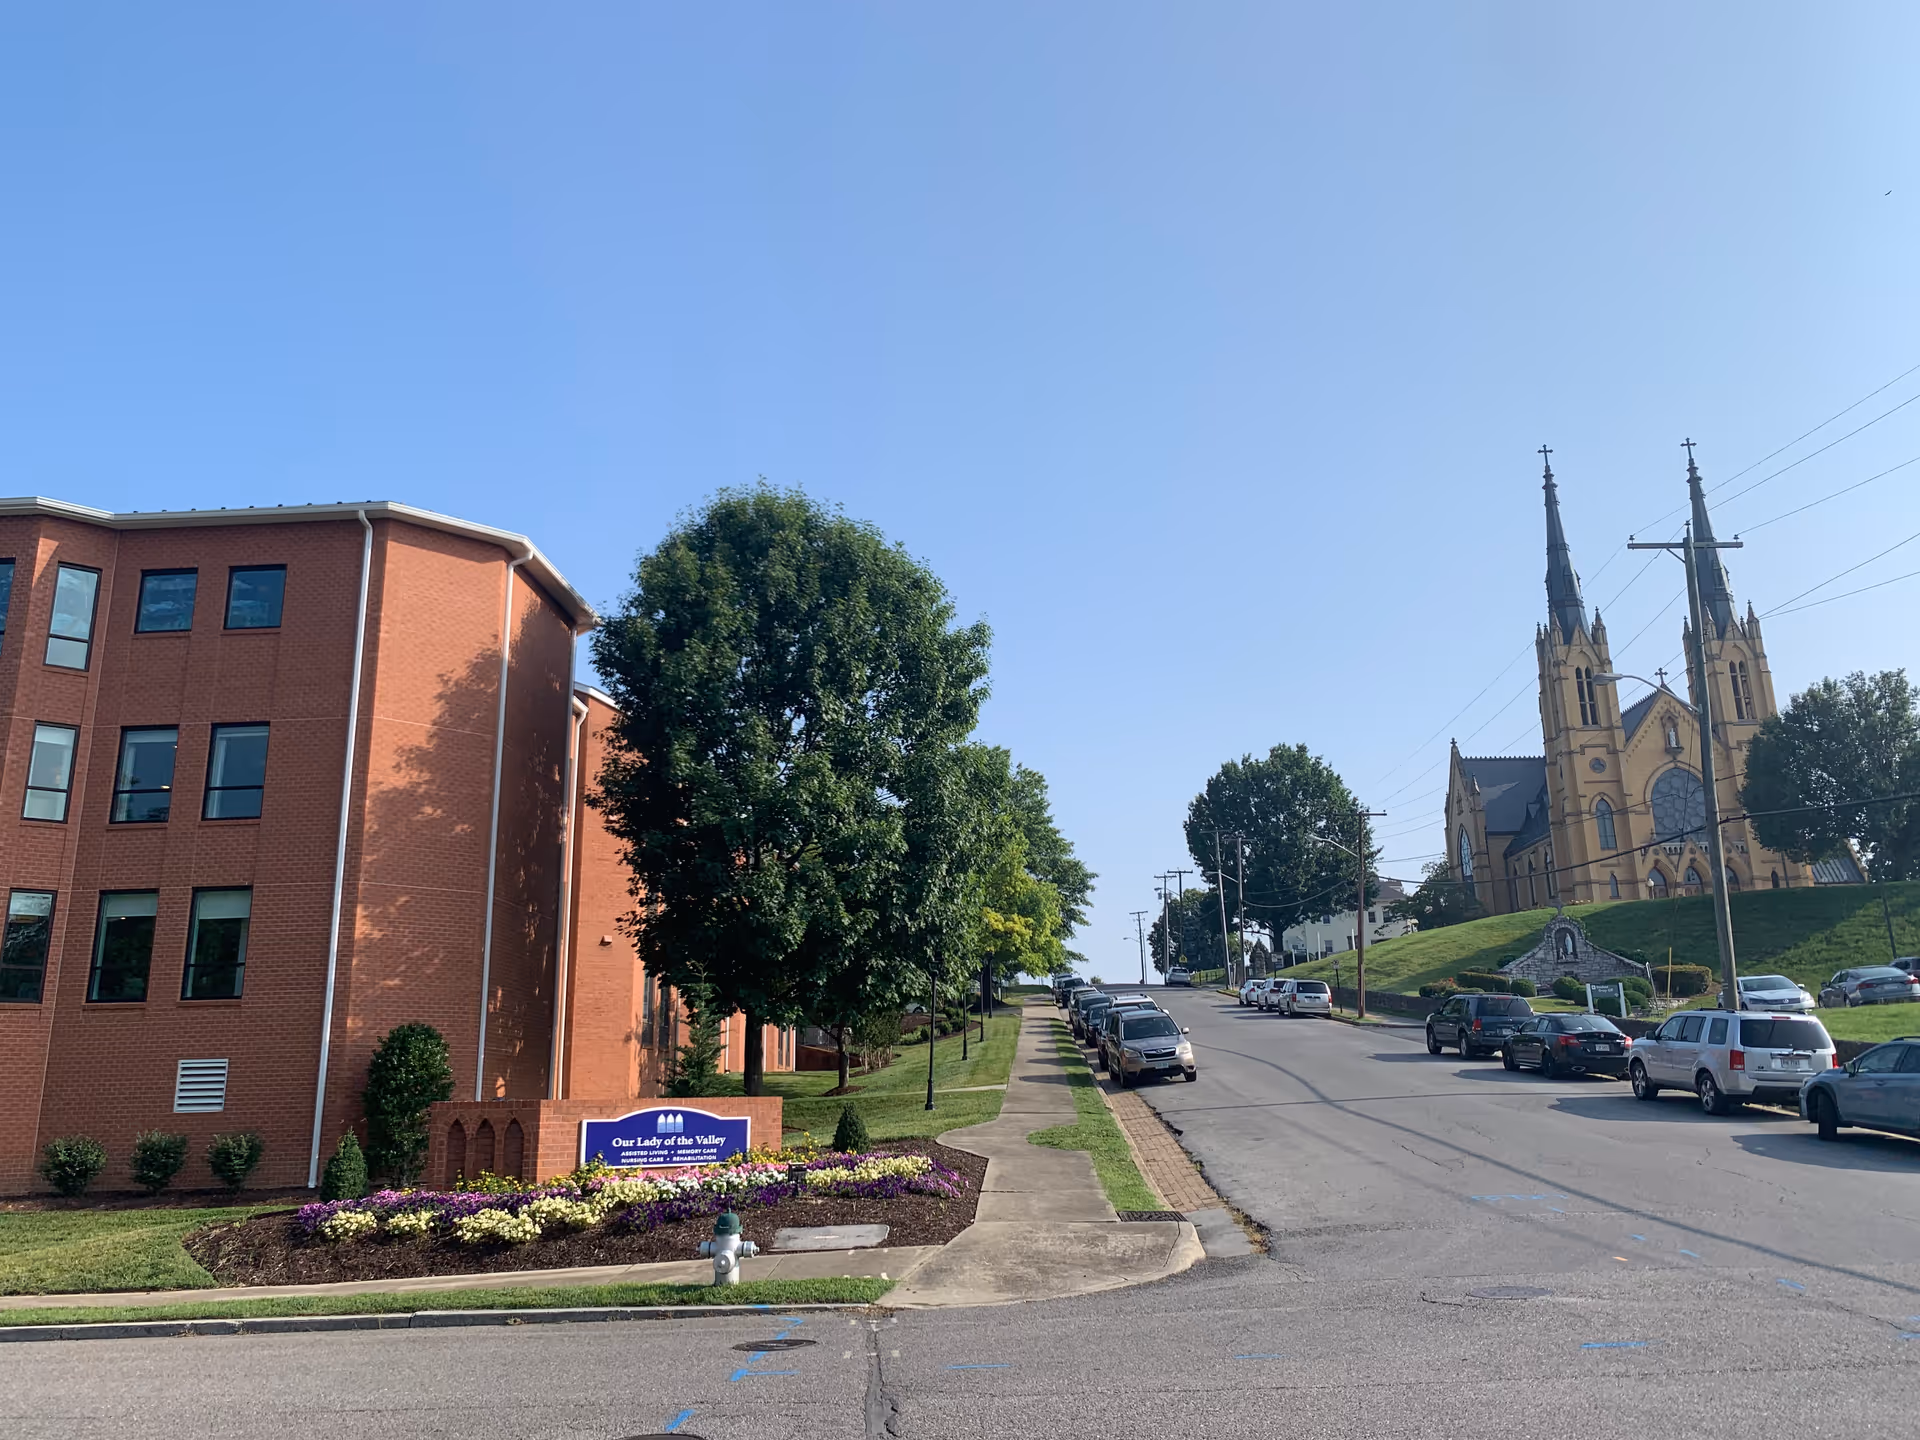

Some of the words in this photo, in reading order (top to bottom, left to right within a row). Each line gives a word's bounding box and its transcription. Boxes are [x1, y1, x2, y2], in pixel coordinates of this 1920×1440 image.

[612, 1138, 635, 1147] Our
[637, 1136, 662, 1148] Lady
[664, 1136, 676, 1146] of
[677, 1136, 694, 1146] the
[696, 1135, 726, 1146] Valley
